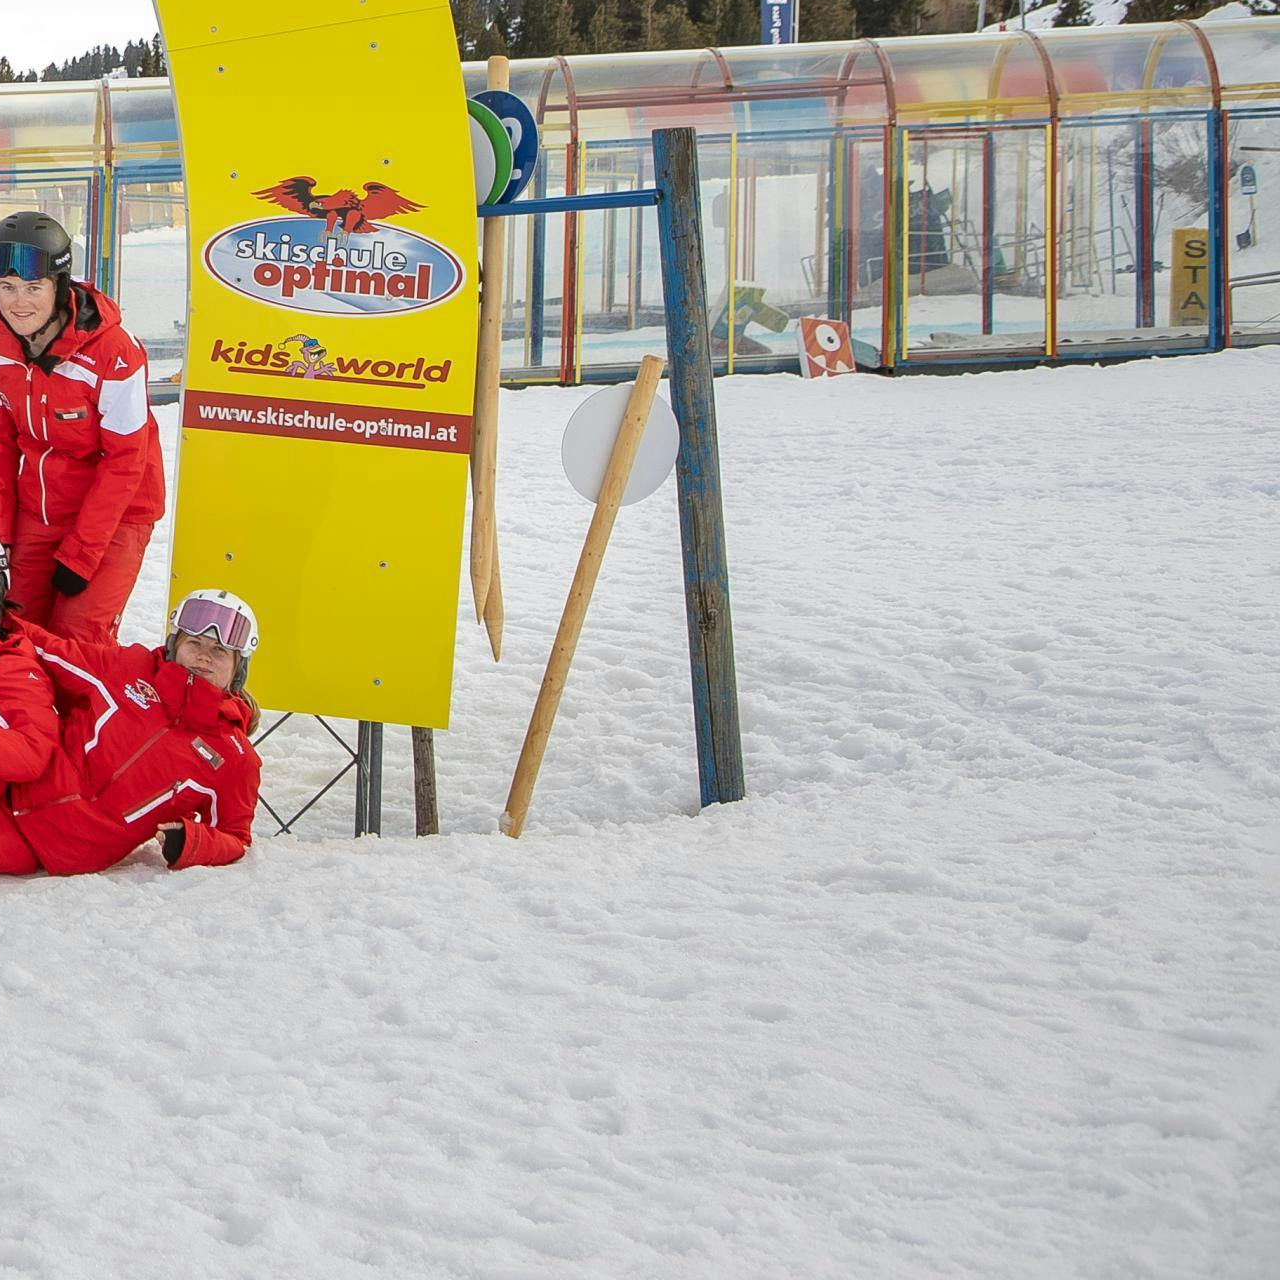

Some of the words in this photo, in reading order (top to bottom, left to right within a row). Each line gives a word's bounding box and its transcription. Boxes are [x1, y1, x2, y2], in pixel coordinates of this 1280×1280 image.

[236, 232, 408, 271] skischule
[252, 253, 431, 300] optimal
[210, 339, 291, 369] kids
[336, 357, 452, 383] world
[199, 405, 458, 443] www.skischule-optimal.at
